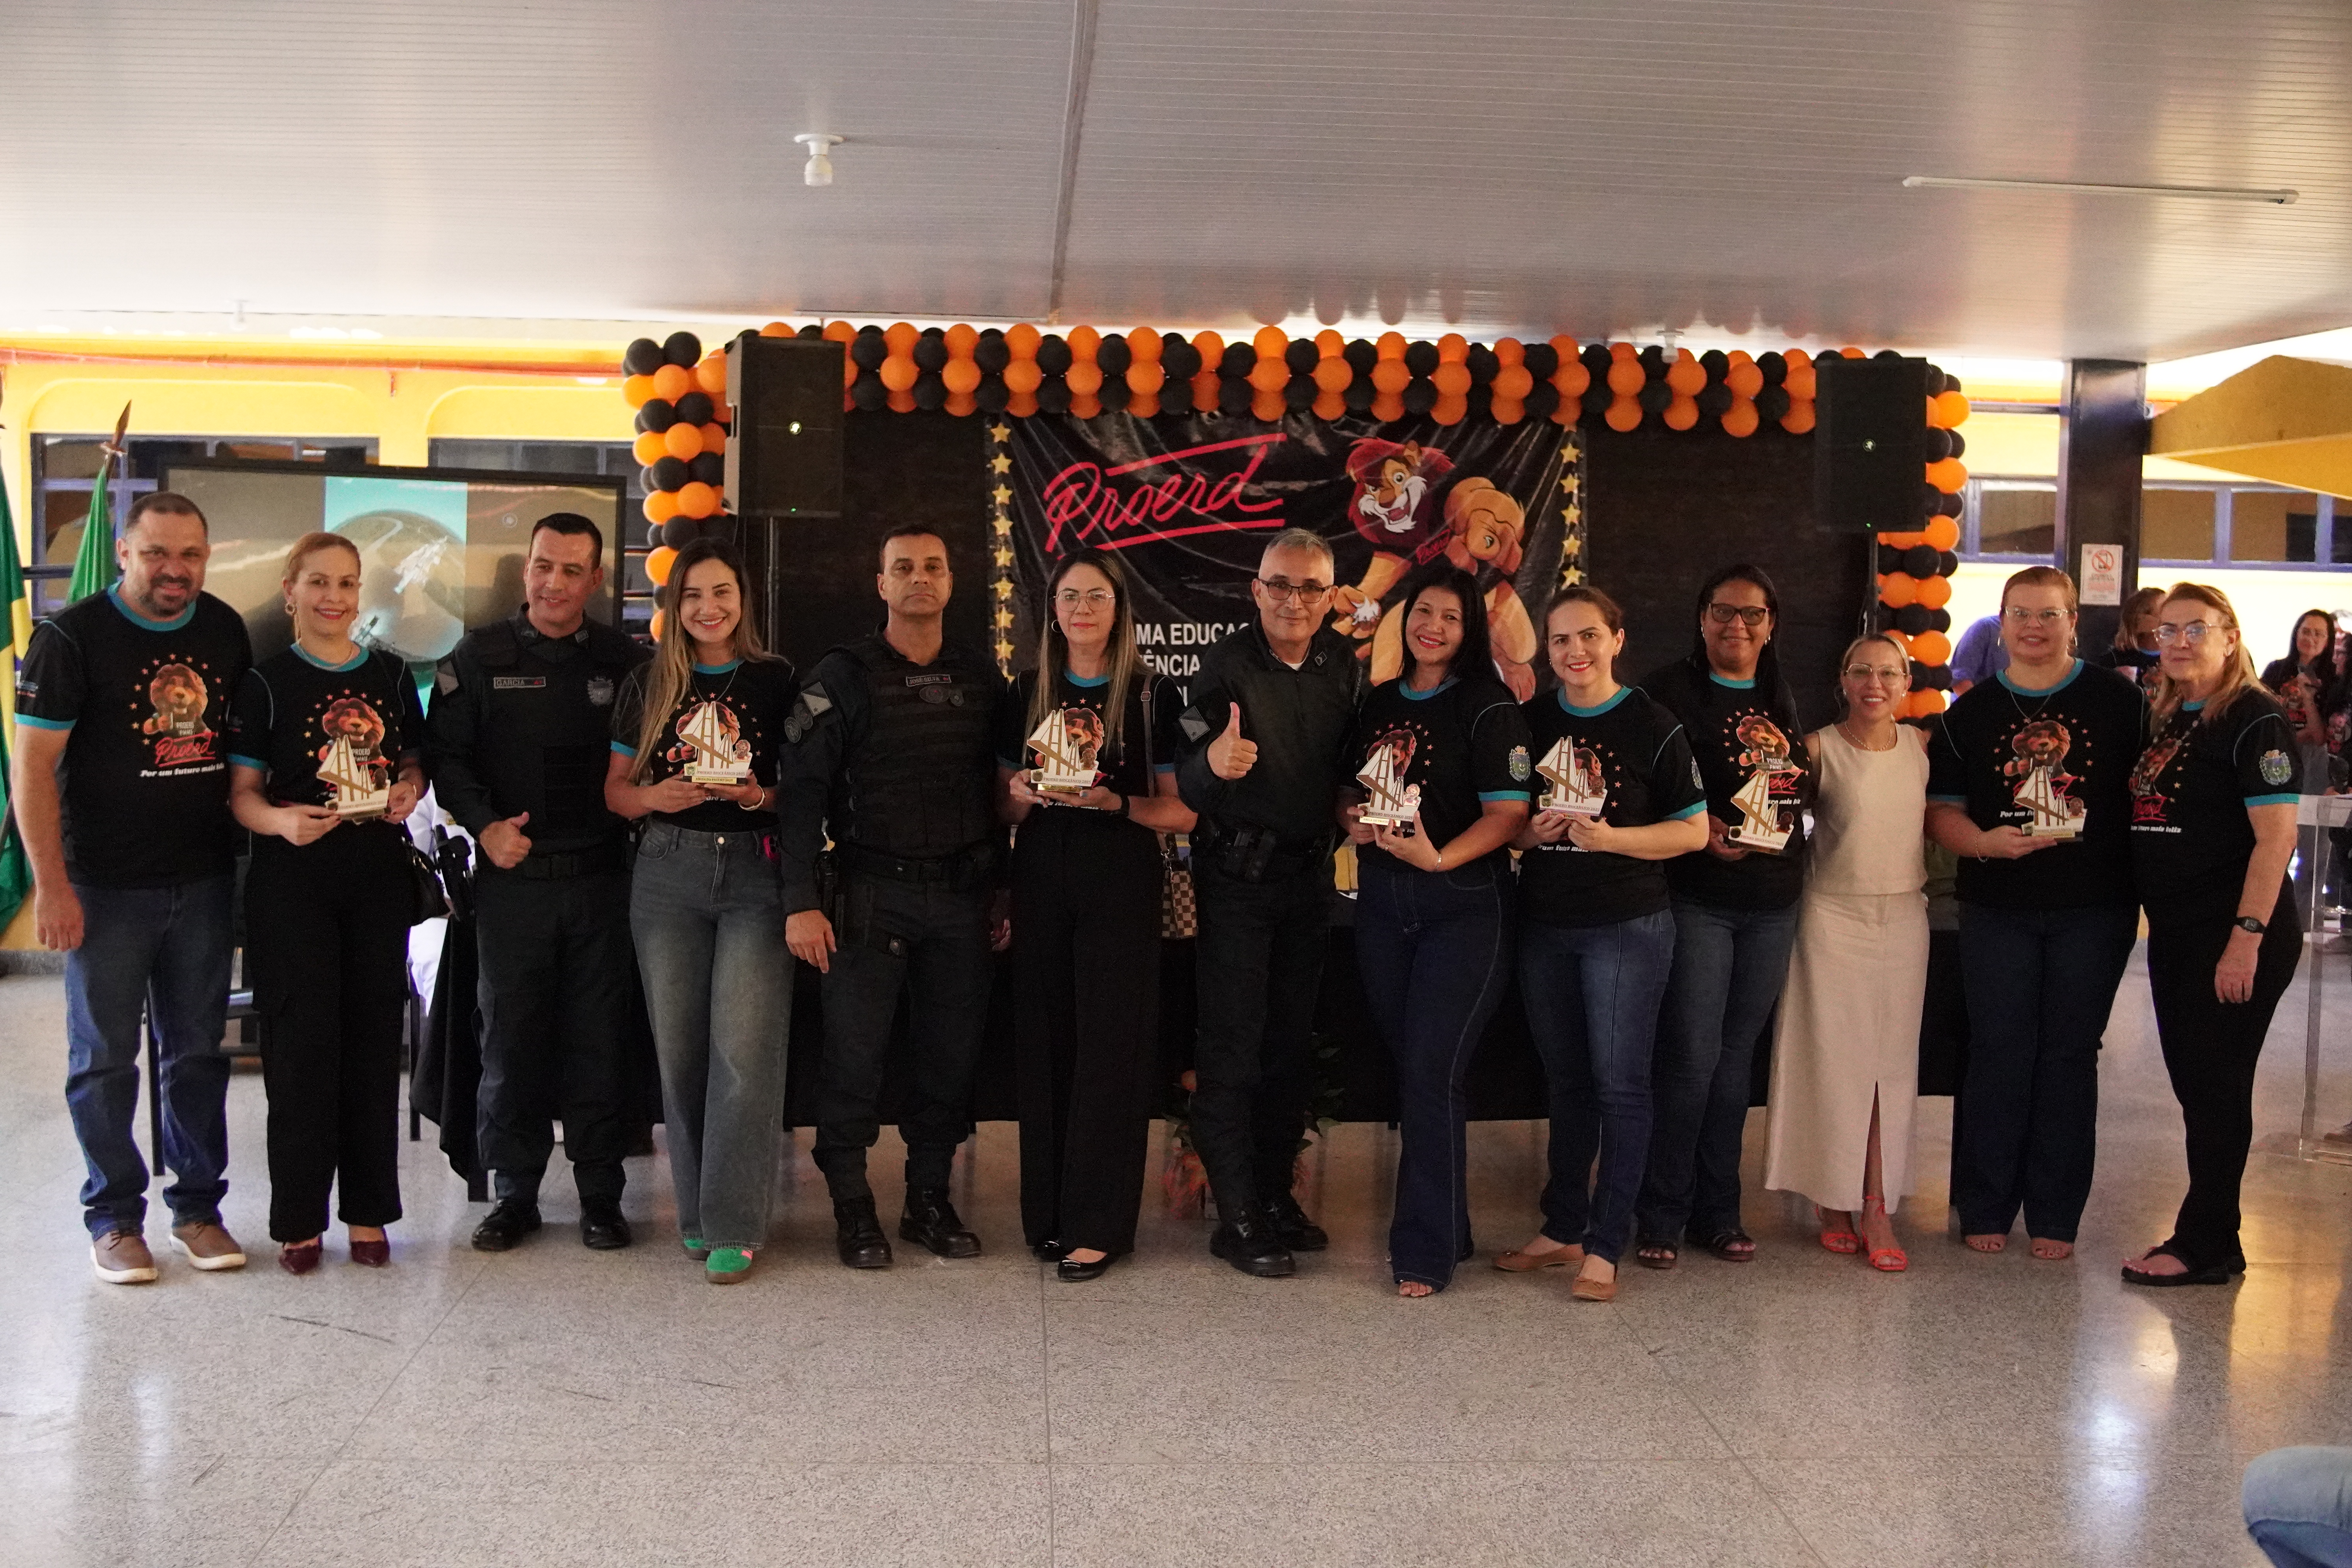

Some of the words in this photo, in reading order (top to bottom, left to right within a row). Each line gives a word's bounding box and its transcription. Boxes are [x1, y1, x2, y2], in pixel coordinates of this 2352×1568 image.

[1043, 443, 1284, 553] Proerd
[1170, 622, 1249, 645] EDUCA
[1139, 649, 1201, 676] ÊNCIA
[155, 731, 216, 764] Proerd
